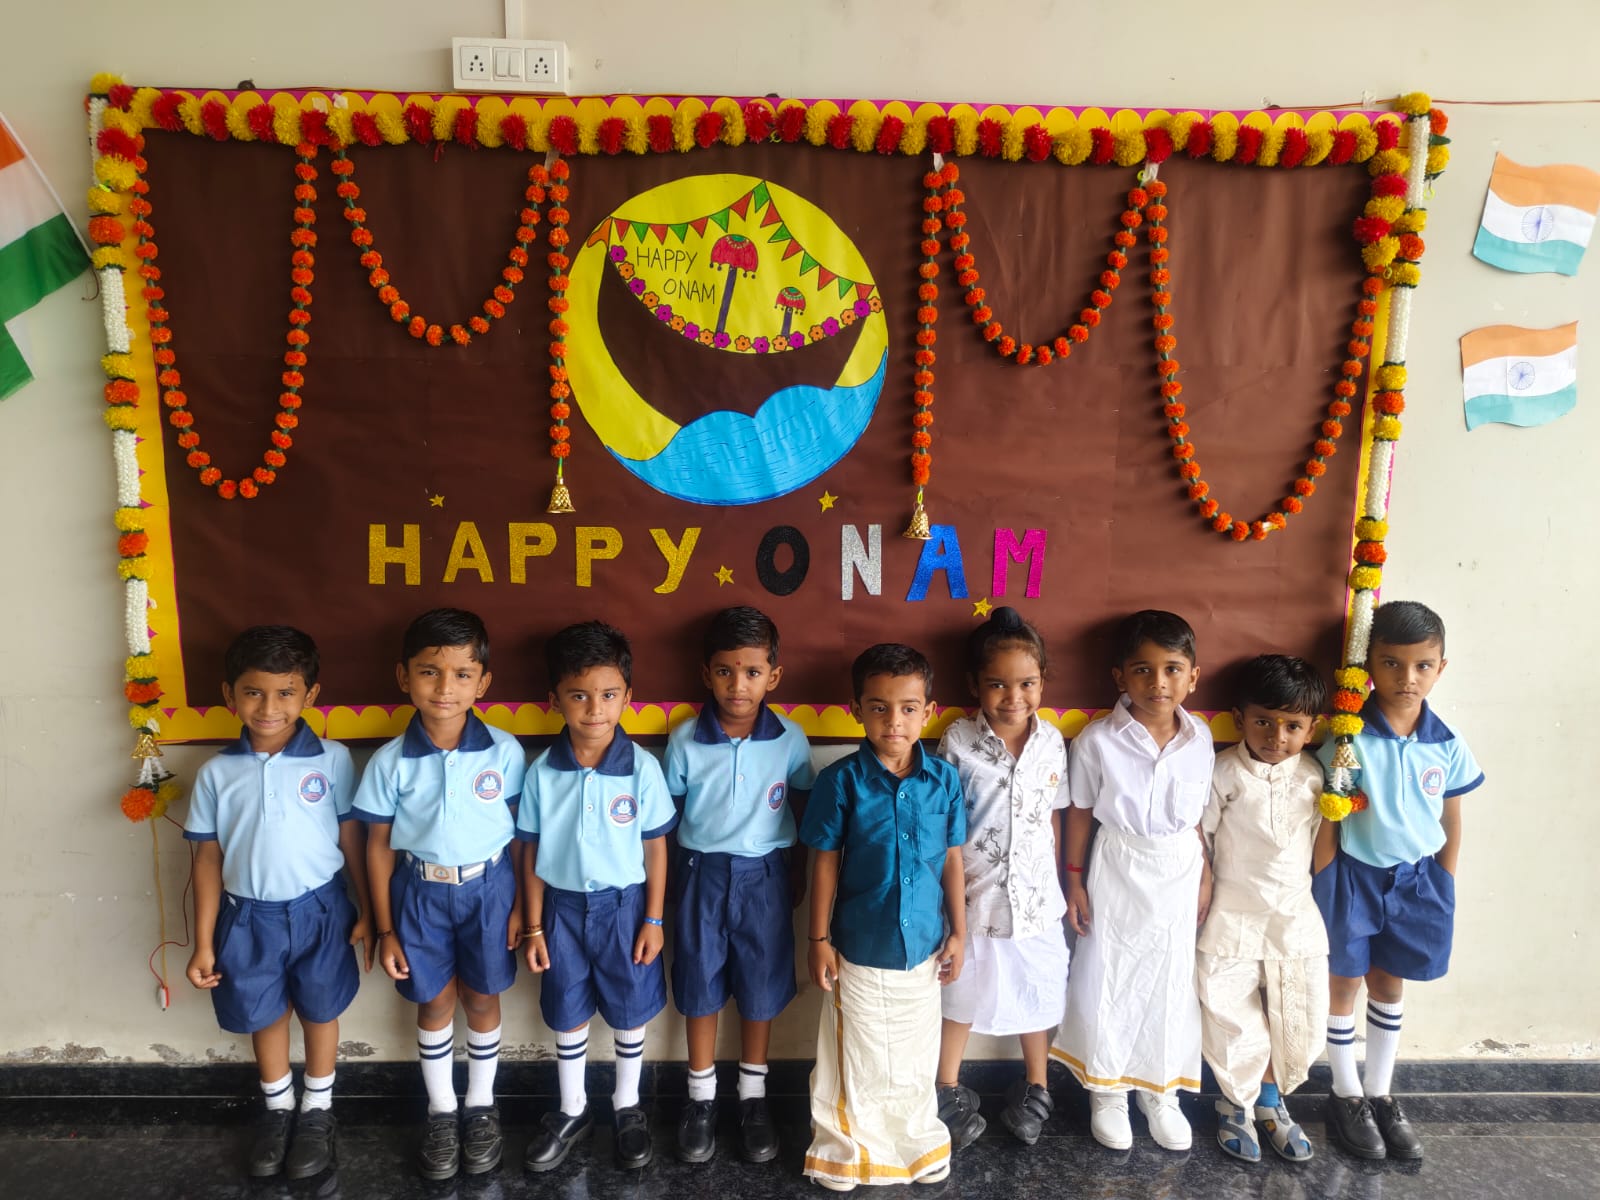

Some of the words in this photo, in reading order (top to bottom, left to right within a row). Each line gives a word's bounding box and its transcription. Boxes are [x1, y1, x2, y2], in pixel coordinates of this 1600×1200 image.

[636, 246, 698, 274] HAPPY
[663, 278, 715, 305] ONAM
[368, 520, 702, 594] HAPPY
[755, 523, 1048, 601] ONAM
